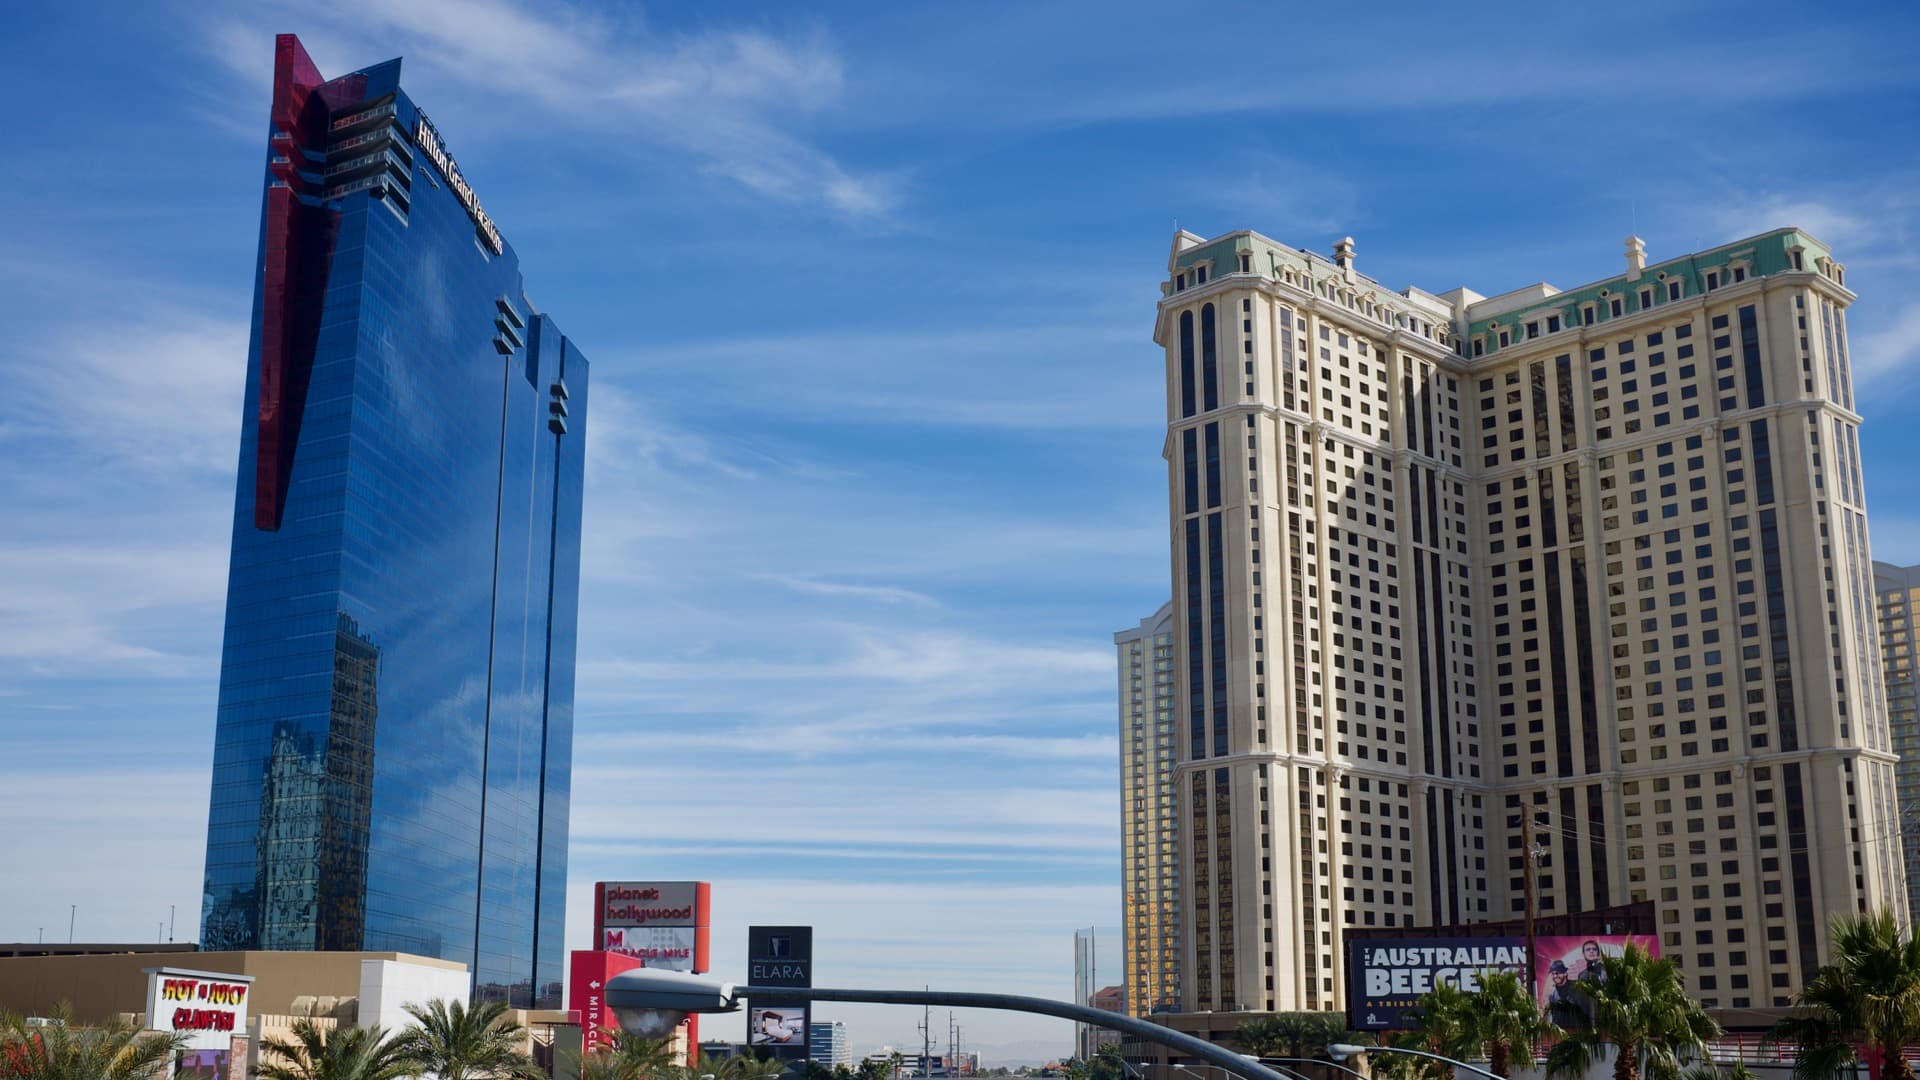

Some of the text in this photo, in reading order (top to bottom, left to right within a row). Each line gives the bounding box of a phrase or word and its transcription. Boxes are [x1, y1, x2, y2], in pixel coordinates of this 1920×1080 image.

[418, 120, 503, 256] Hilton Grand Vacations
[607, 886, 660, 904] planet
[607, 904, 693, 924] hollywood
[607, 930, 623, 947] M
[607, 948, 690, 958] RACLE MILE
[1372, 947, 1526, 966] AUSTRALIAN
[753, 965, 805, 979] ELARA
[162, 979, 198, 1000] HOT
[208, 983, 247, 1005] JUICY
[1365, 968, 1432, 997] BEE
[588, 996, 599, 1053] MIRACLE
